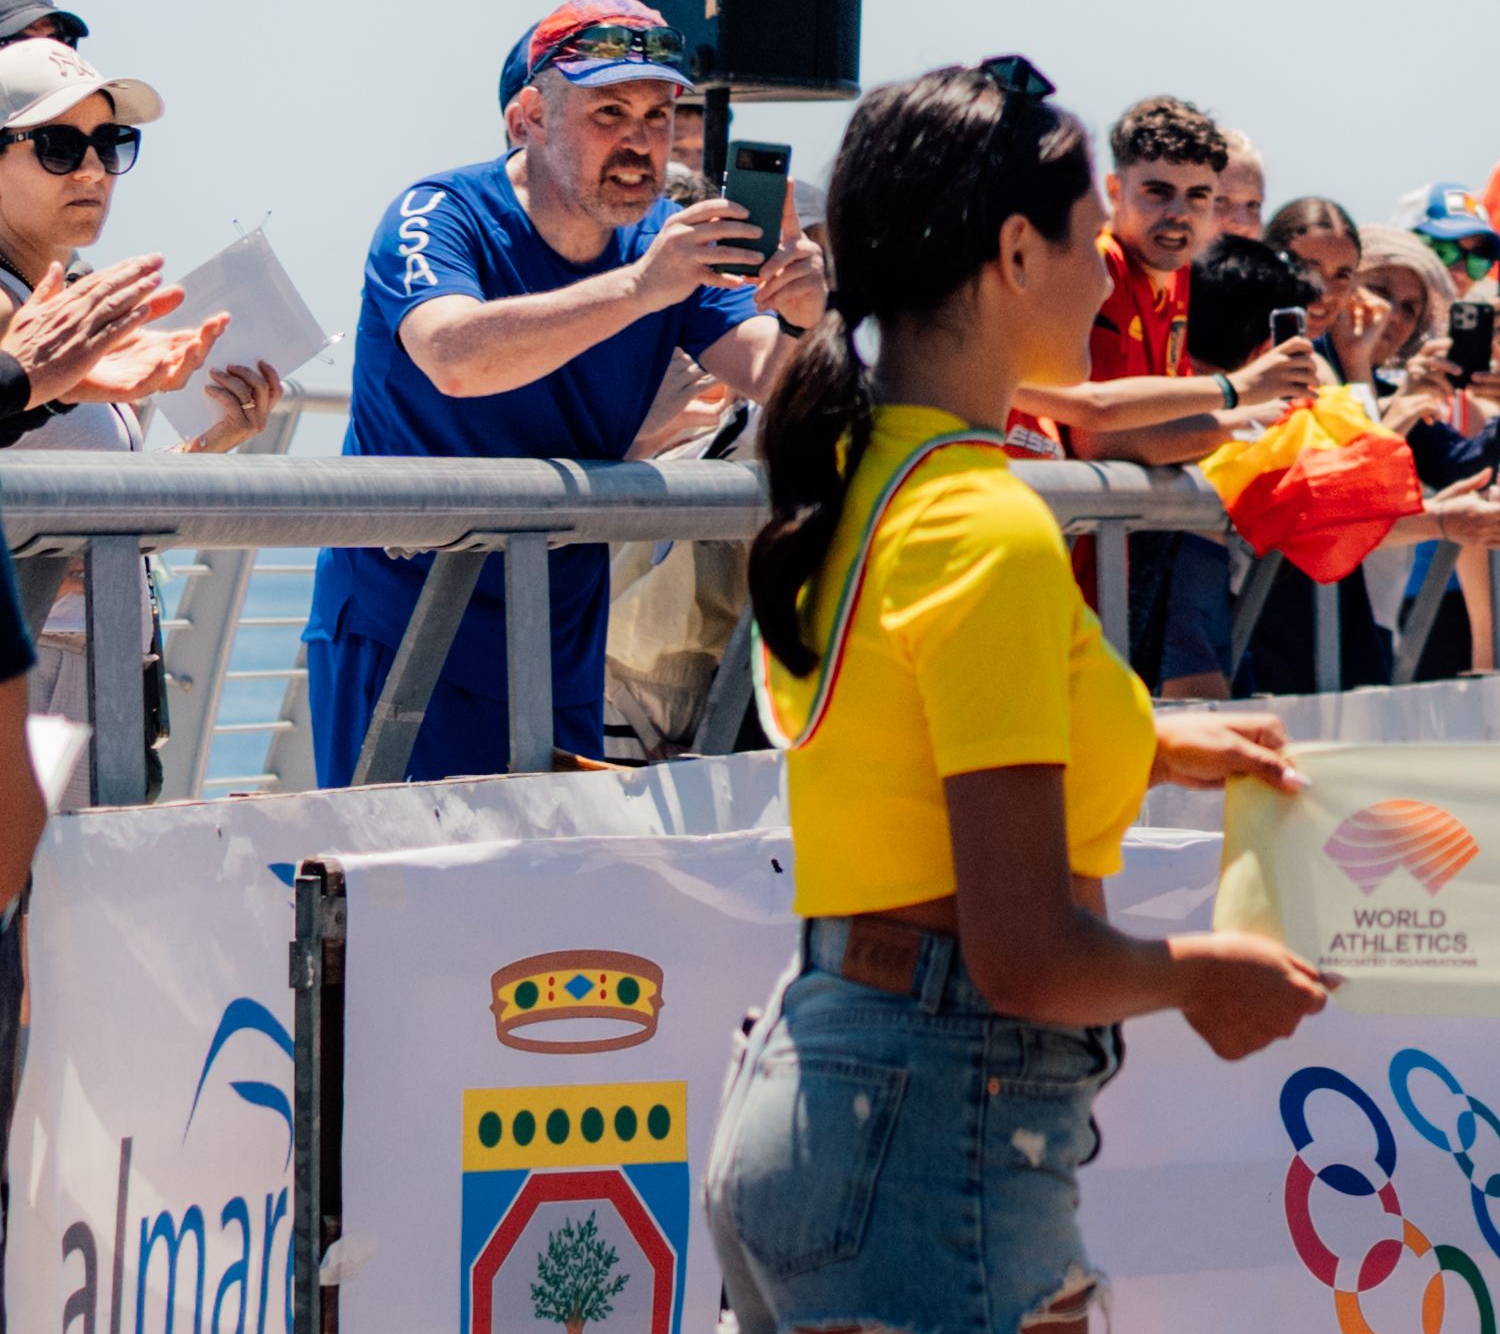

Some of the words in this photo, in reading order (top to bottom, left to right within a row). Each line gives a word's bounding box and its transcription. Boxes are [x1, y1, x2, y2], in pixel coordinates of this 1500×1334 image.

[399, 190, 446, 296] USA
[1353, 909, 1447, 928] WORLD
[1329, 933, 1468, 953] ATHLETICS
